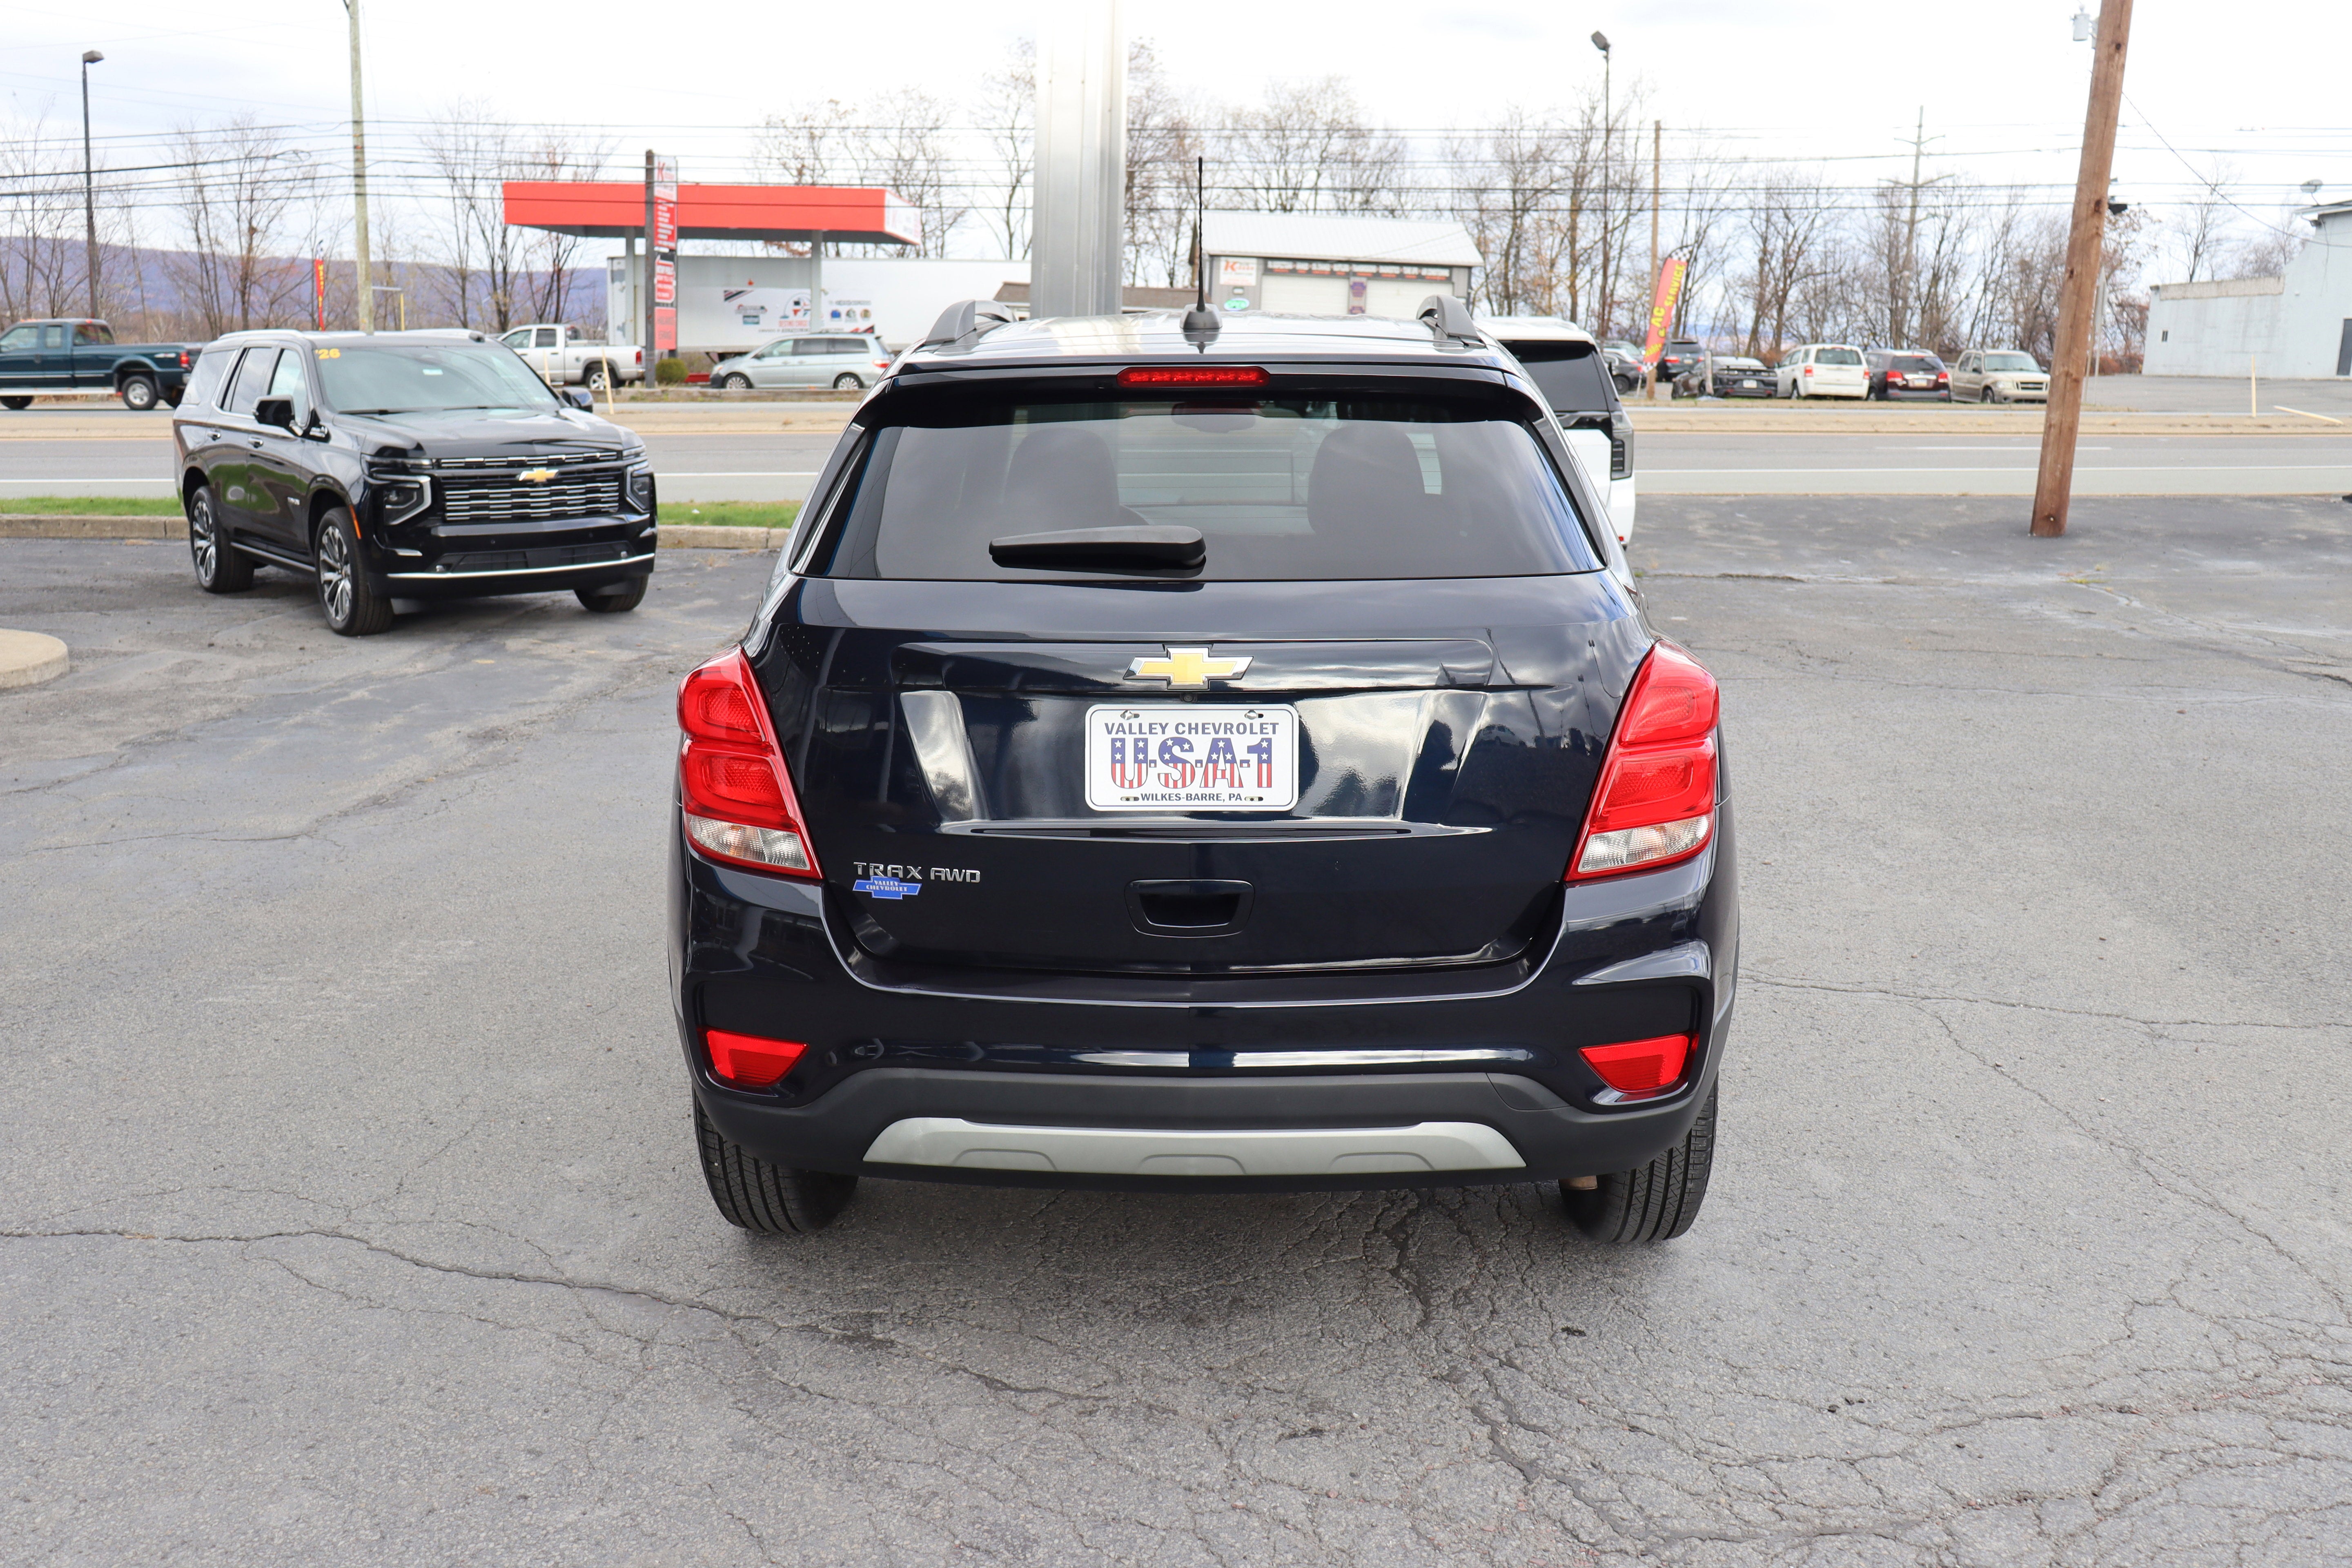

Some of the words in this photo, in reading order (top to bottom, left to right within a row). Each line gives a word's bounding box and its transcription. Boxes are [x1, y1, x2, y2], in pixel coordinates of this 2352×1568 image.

[1650, 306, 1666, 328] AC
[1664, 263, 1686, 307] SERVICE
[1104, 722, 1169, 735] VALLEY
[1175, 722, 1279, 735] CHEVROLET
[1140, 793, 1225, 802] WILKES-BARRE,
[1229, 793, 1242, 801] PA
[853, 862, 922, 880] TRAX
[930, 867, 980, 883] AWD
